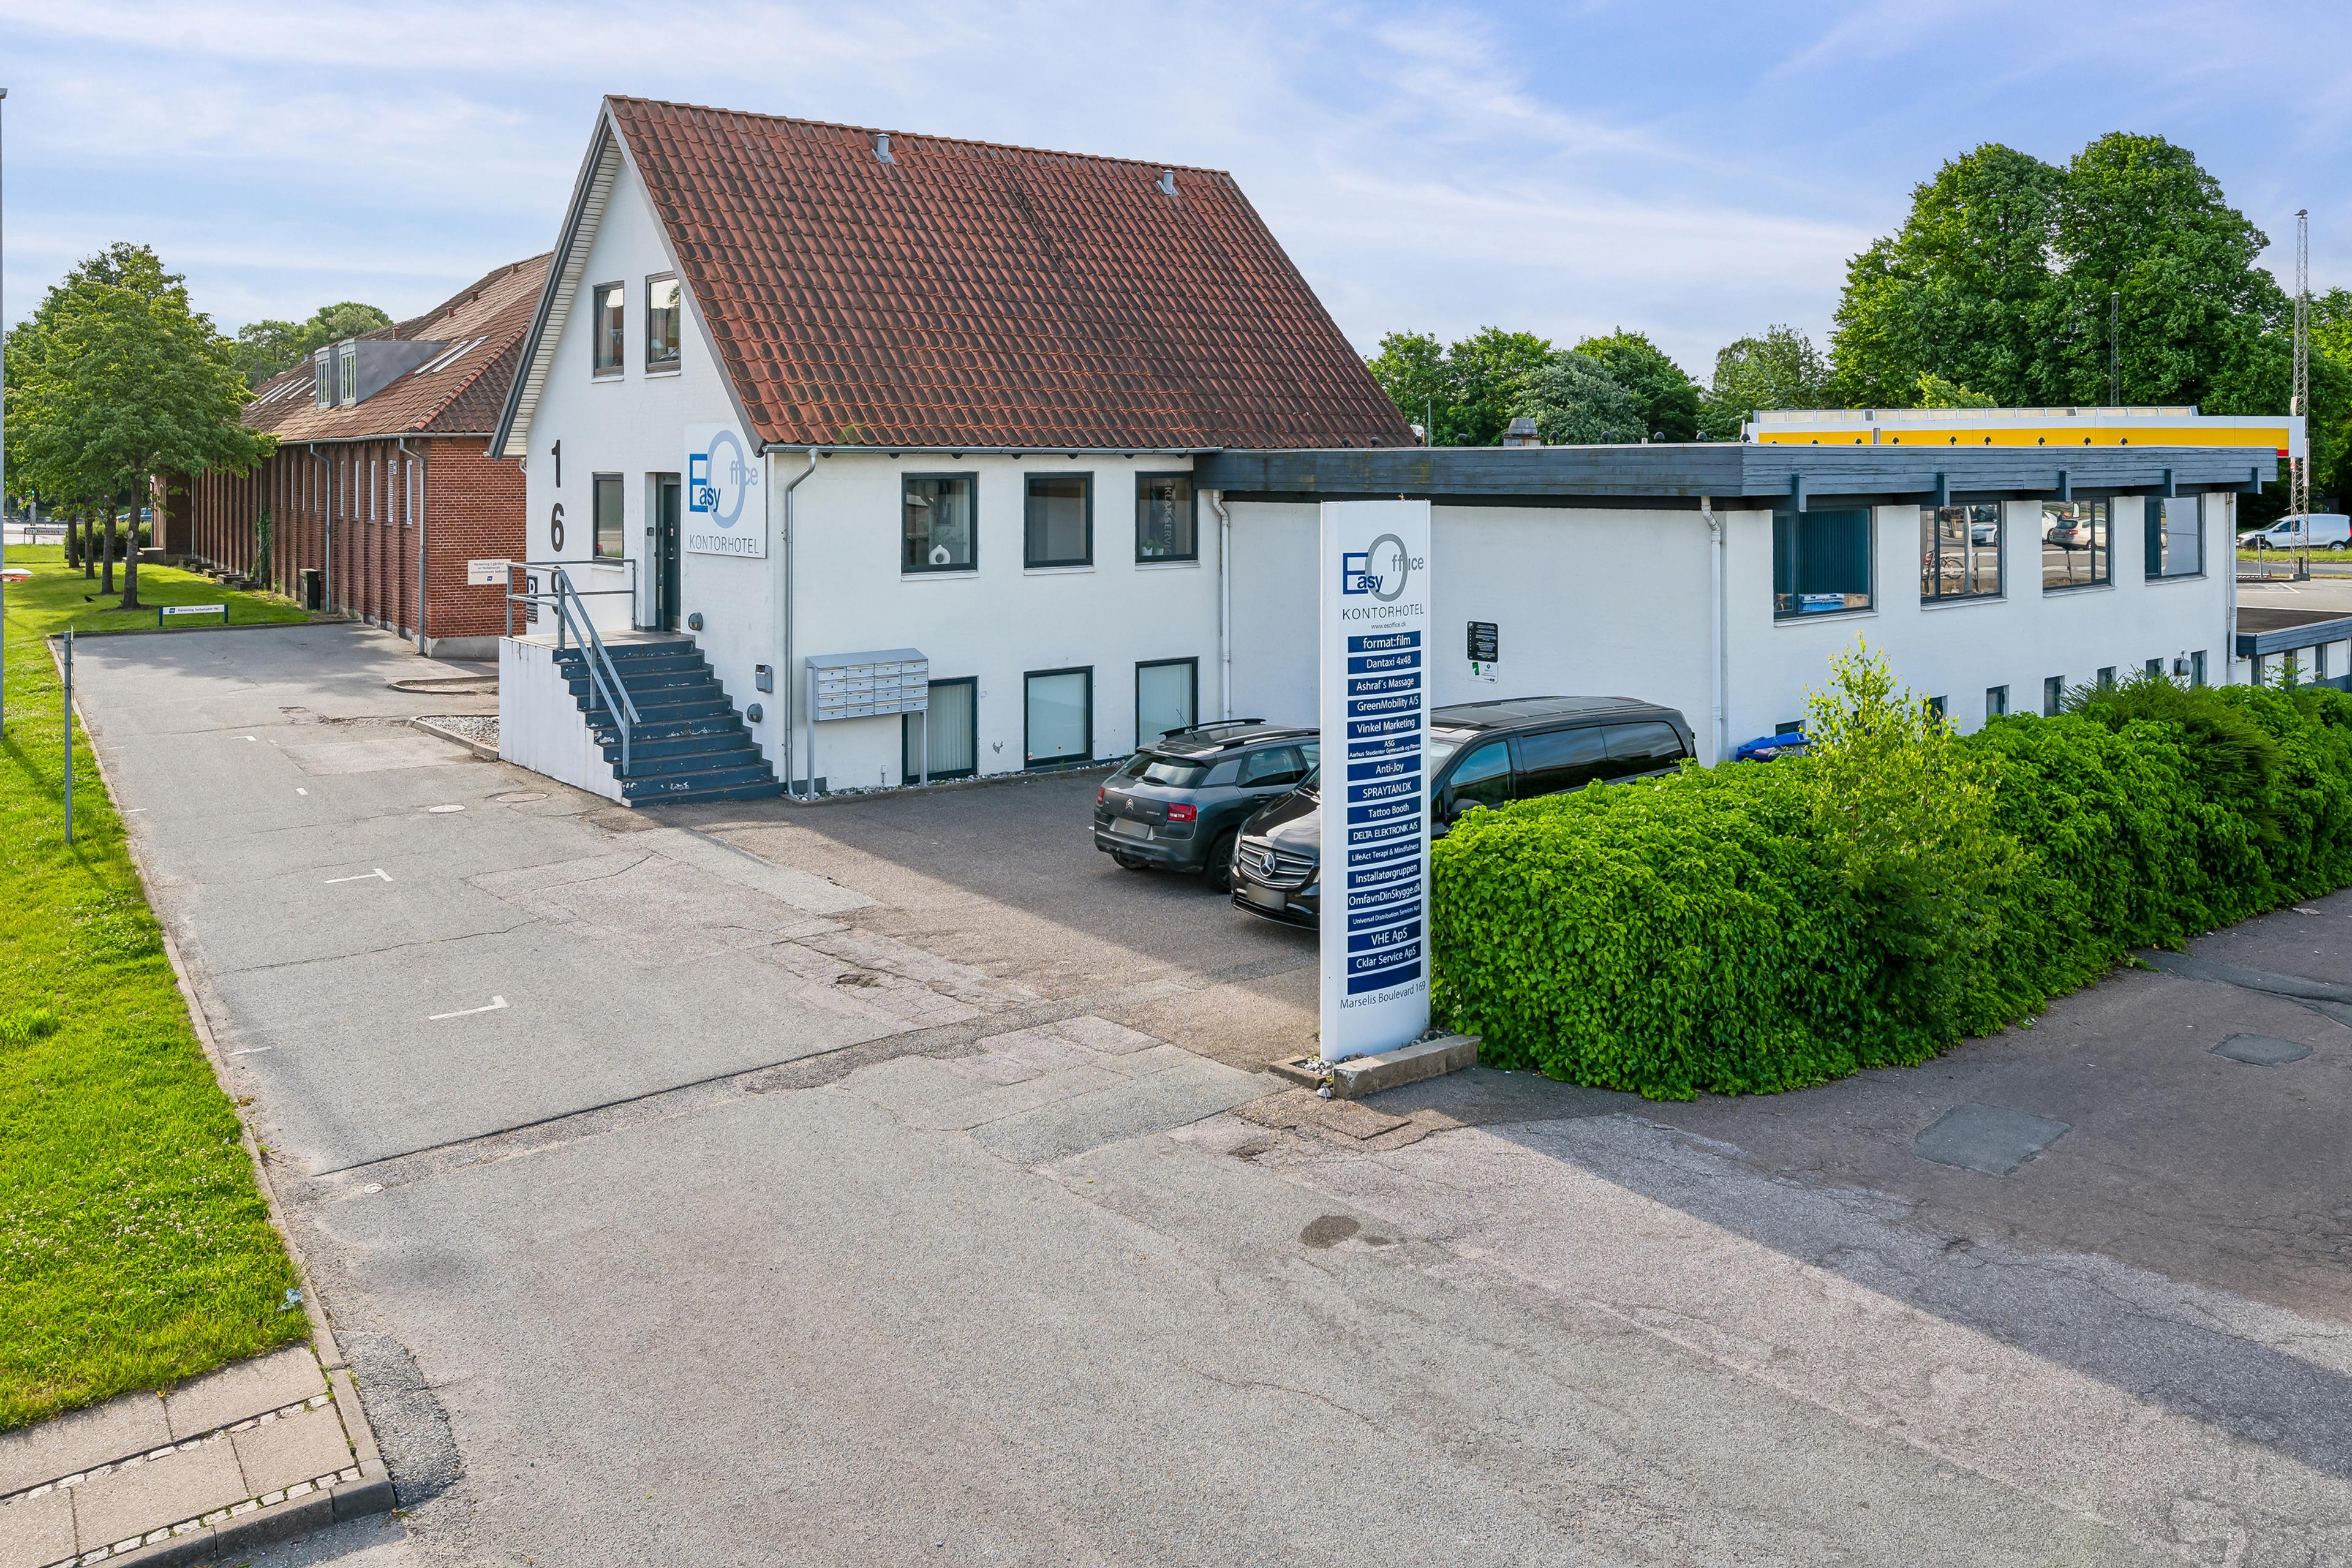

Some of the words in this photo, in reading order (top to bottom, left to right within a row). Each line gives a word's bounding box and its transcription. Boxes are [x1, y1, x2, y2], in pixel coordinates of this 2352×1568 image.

[689, 453, 721, 513] Easy
[690, 535, 759, 554] KONTORHOTEL
[1343, 552, 1384, 595] Easy
[1343, 603, 1425, 620] KONTORHOTEL
[1363, 635, 1411, 649] format:film
[1366, 657, 1395, 669] Dantaxi
[1396, 655, 1411, 666] 4x48
[1388, 677, 1414, 689] Massage
[1357, 697, 1408, 712] GreenMobility
[1409, 695, 1419, 705] A/S
[1357, 721, 1381, 734] Vinkel
[1383, 718, 1415, 732] Marketing
[1385, 745, 1404, 754] Gymnastik
[1376, 763, 1404, 775] Anti-Joy
[1363, 782, 1411, 799] SPRAYTAN.DK
[1368, 806, 1390, 818] Tattoo
[1392, 803, 1409, 815] Booth
[1353, 830, 1373, 841] DELTA
[1374, 824, 1408, 838] ELEKTRONIK
[1409, 821, 1418, 831] A/S
[1352, 851, 1371, 861] LifeAct
[1372, 849, 1389, 859] Terapi
[1394, 842, 1419, 854] Mindfulness
[1355, 864, 1417, 883] Installatørgruppen
[1349, 883, 1421, 906] OmfavnDinSkygge.dk
[1353, 915, 1374, 925] Universal
[1375, 911, 1400, 921] Distribution
[1399, 907, 1414, 916] Services
[1371, 932, 1390, 946] VHE
[1392, 927, 1408, 941] ApS
[1356, 955, 1376, 968] Cklar
[1378, 951, 1403, 964] Service
[1404, 946, 1416, 958] ApS
[1340, 994, 1376, 1009] Marselis
[1378, 983, 1414, 1003] Boulevard
[1415, 981, 1426, 993] 169
